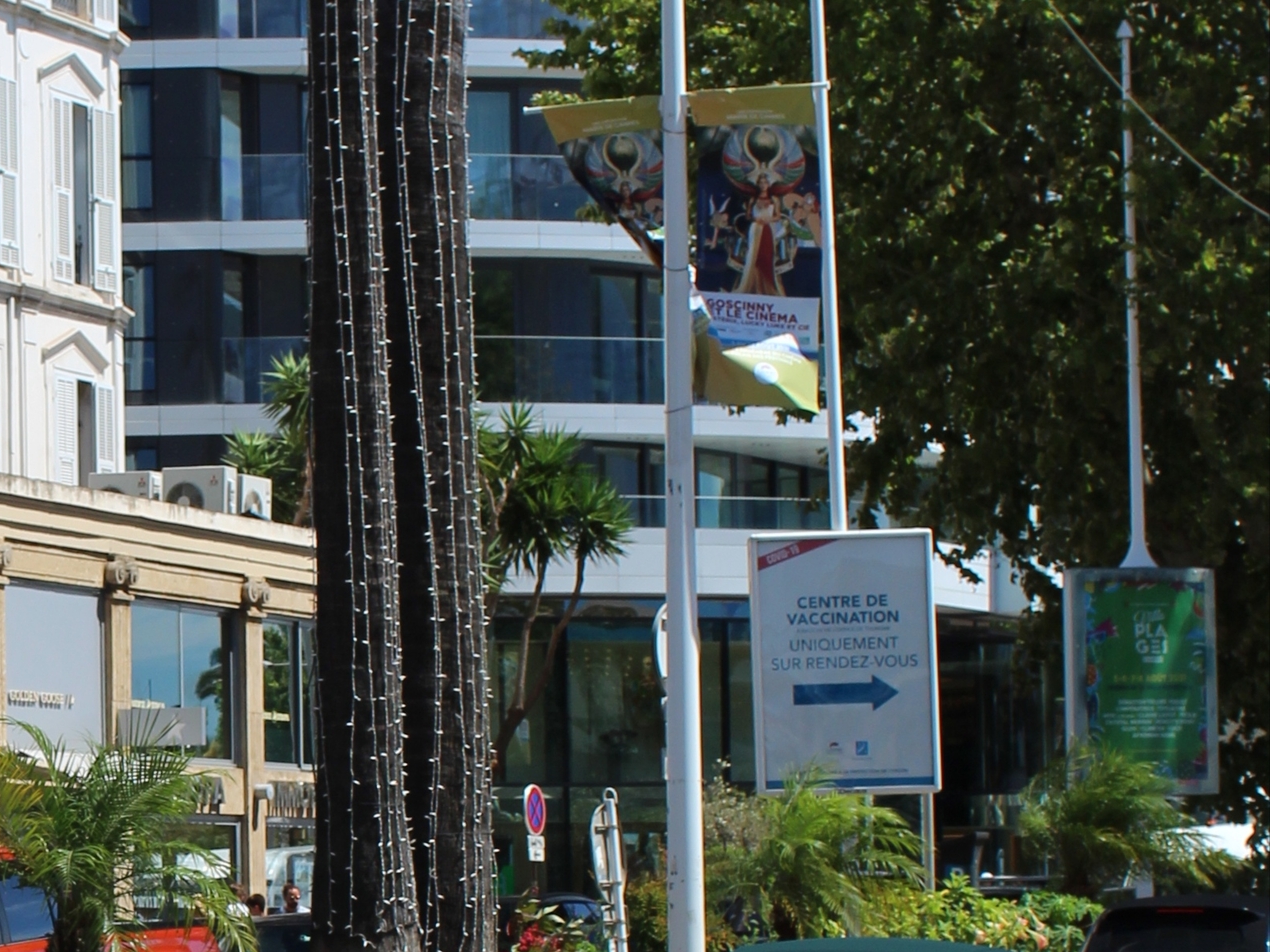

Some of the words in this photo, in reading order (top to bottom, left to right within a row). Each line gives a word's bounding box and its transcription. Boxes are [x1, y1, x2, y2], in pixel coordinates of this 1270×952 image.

[726, 309, 741, 318] LE
[797, 595, 861, 609] CENTRE
[866, 594, 888, 607] DE
[787, 610, 899, 626] VACCINATION
[790, 636, 899, 652] UNIQUEMENT
[771, 658, 801, 671] SUR
[806, 654, 918, 670] RENDEZ-VOUS
